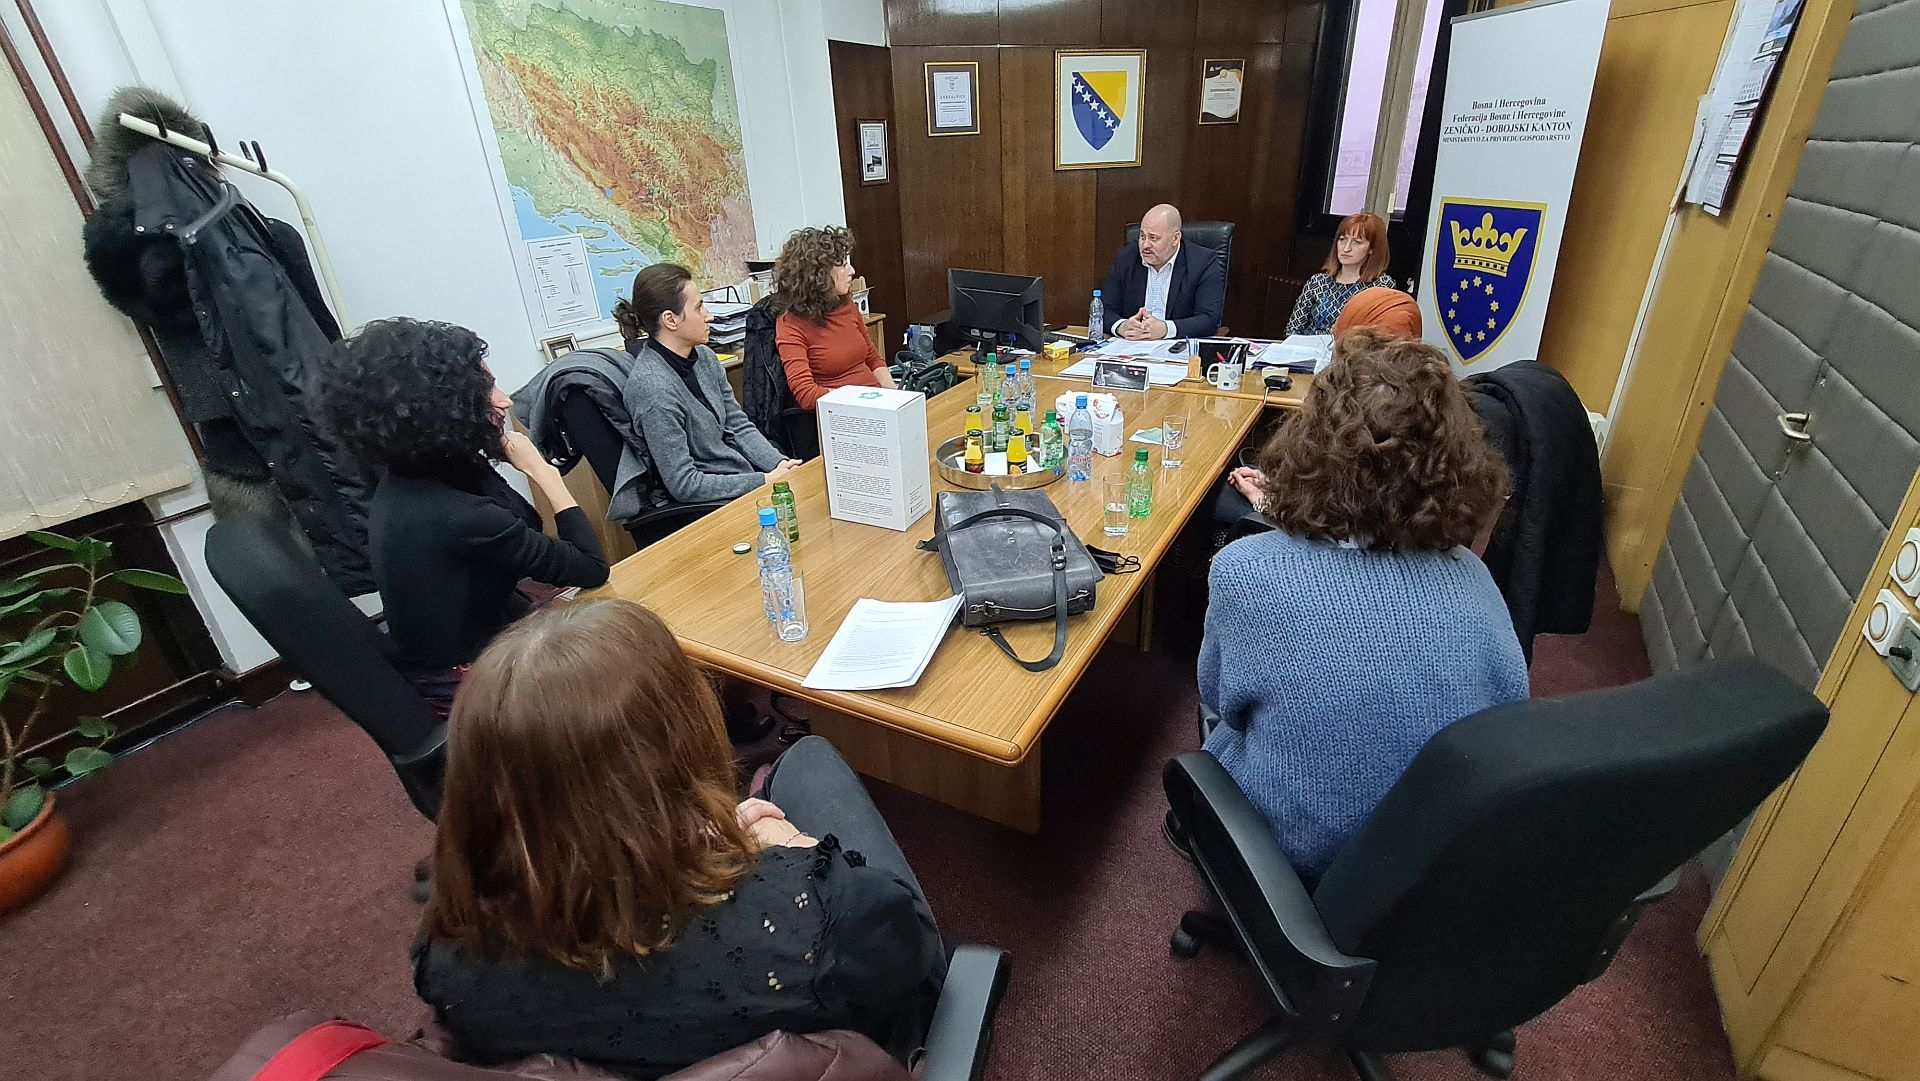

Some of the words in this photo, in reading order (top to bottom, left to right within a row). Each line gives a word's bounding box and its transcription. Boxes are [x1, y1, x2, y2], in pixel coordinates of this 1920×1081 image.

[1472, 101, 1493, 110] Bosna
[1499, 96, 1546, 108] Hercegovina
[1453, 113, 1488, 123] Federacija
[1489, 112, 1511, 121] Bosne
[1517, 108, 1566, 120] Hercegovine
[1444, 123, 1480, 134] ZENIČKO
[1485, 122, 1530, 134] DOBOJSKI
[1531, 121, 1573, 132] KANTON
